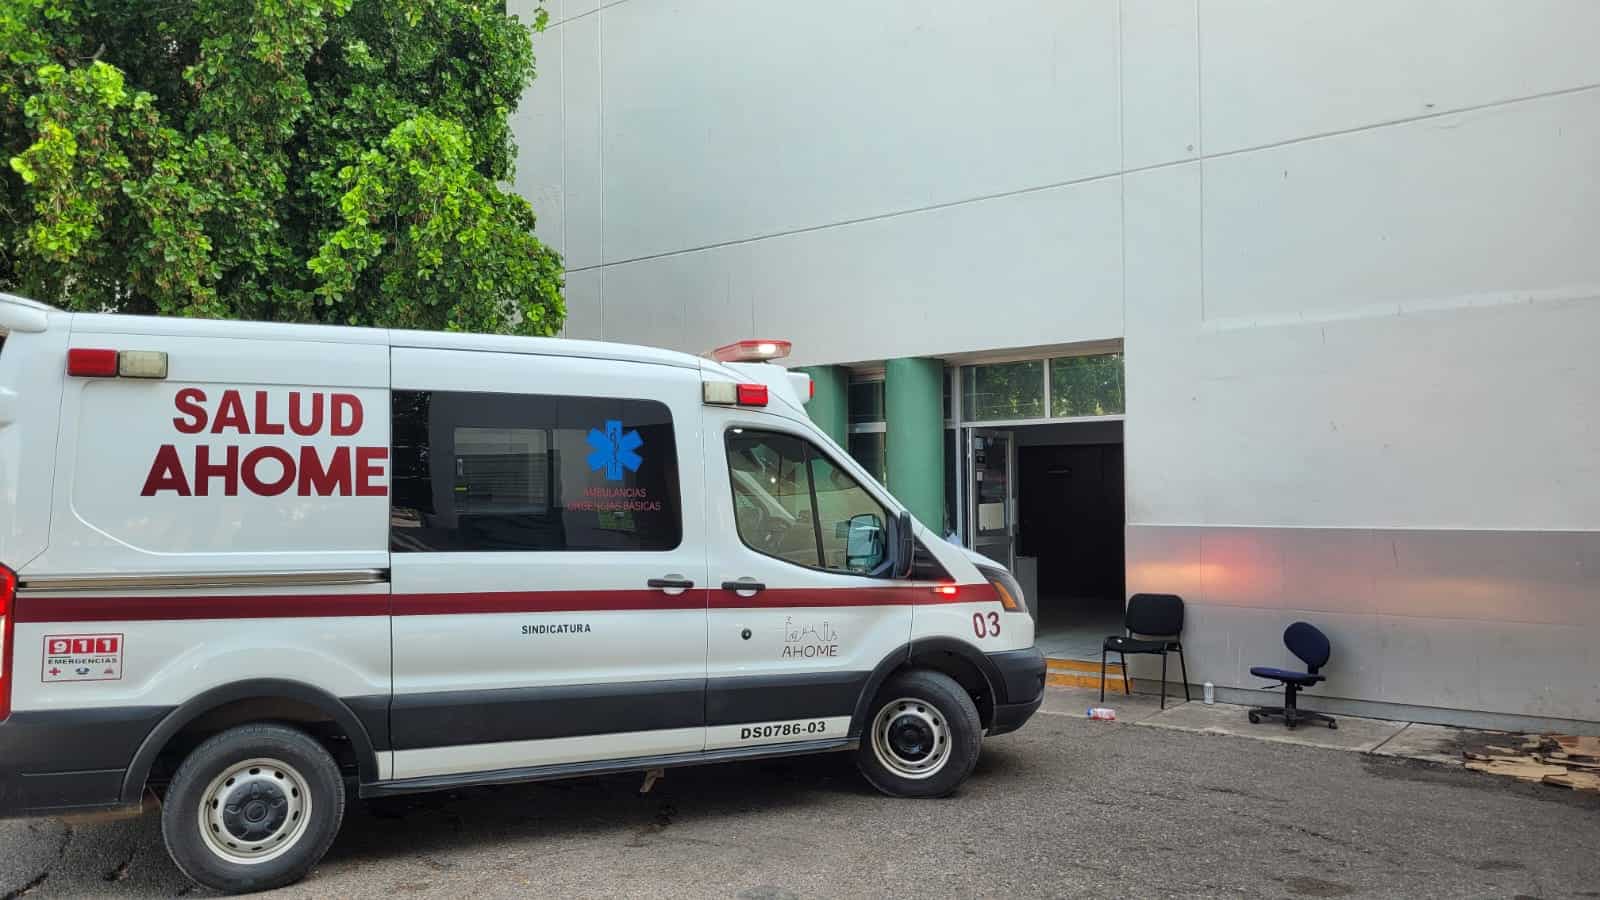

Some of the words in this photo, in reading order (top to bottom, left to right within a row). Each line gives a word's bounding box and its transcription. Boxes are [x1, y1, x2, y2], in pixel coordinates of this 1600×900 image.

[173, 388, 364, 436] SALUD
[140, 444, 389, 496] AHOME
[584, 488, 647, 497] AMBULANCIAS
[521, 623, 592, 635] SINDICATURA
[973, 611, 1001, 638] 03
[52, 638, 114, 654] 911
[782, 644, 839, 657] AHOME
[740, 721, 826, 740] DS0786-03
